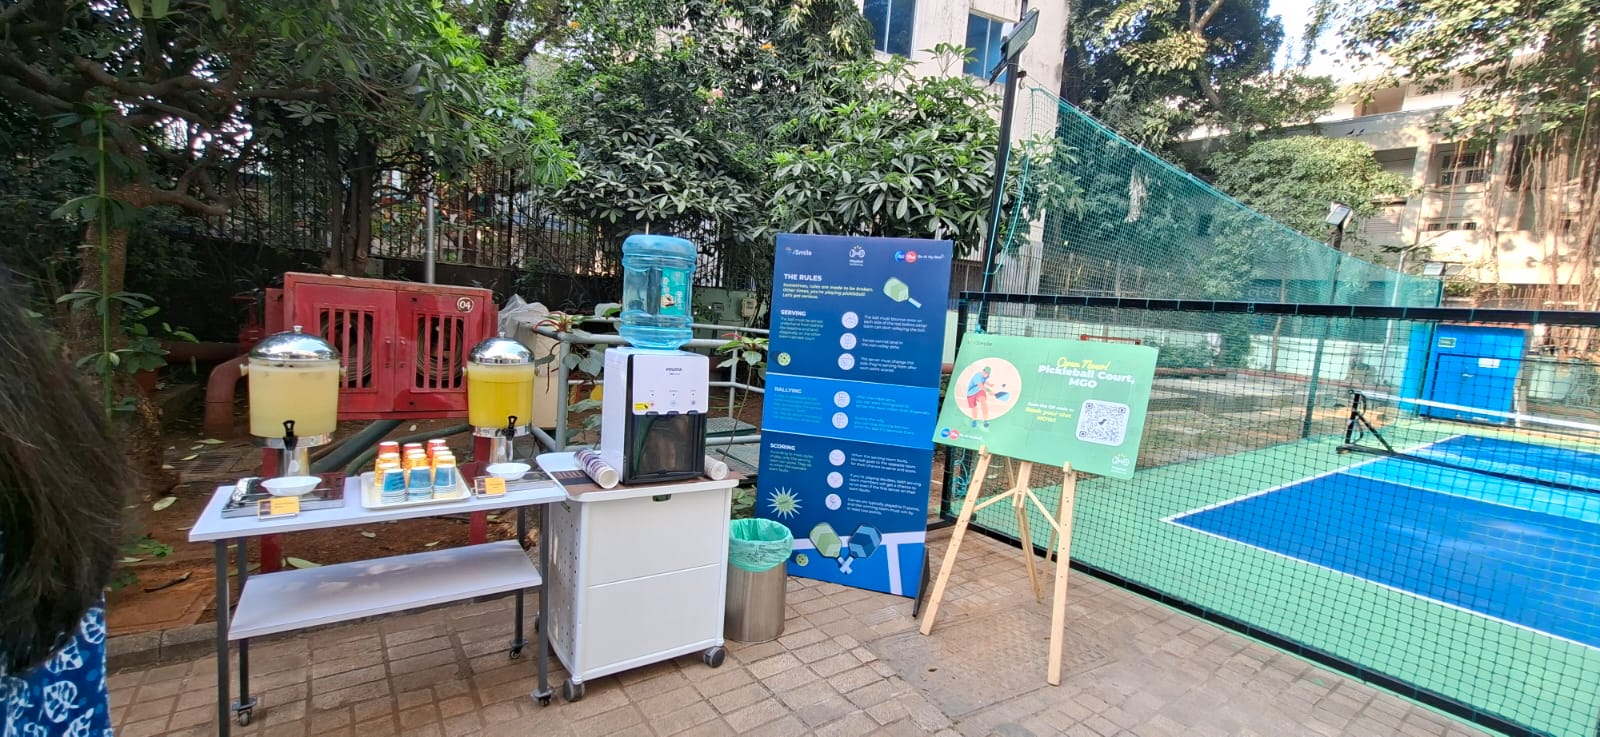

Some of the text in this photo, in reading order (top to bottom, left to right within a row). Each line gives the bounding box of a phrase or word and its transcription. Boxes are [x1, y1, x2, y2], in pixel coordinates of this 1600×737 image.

[784, 273, 822, 282] THE RULES
[460, 300, 471, 310] 04
[1056, 357, 1112, 370] Open Now!
[1038, 364, 1136, 384] Pickleball Court,
[1068, 378, 1098, 389] MGO
[774, 386, 803, 394] RALLYING
[770, 443, 796, 451] SCORING
